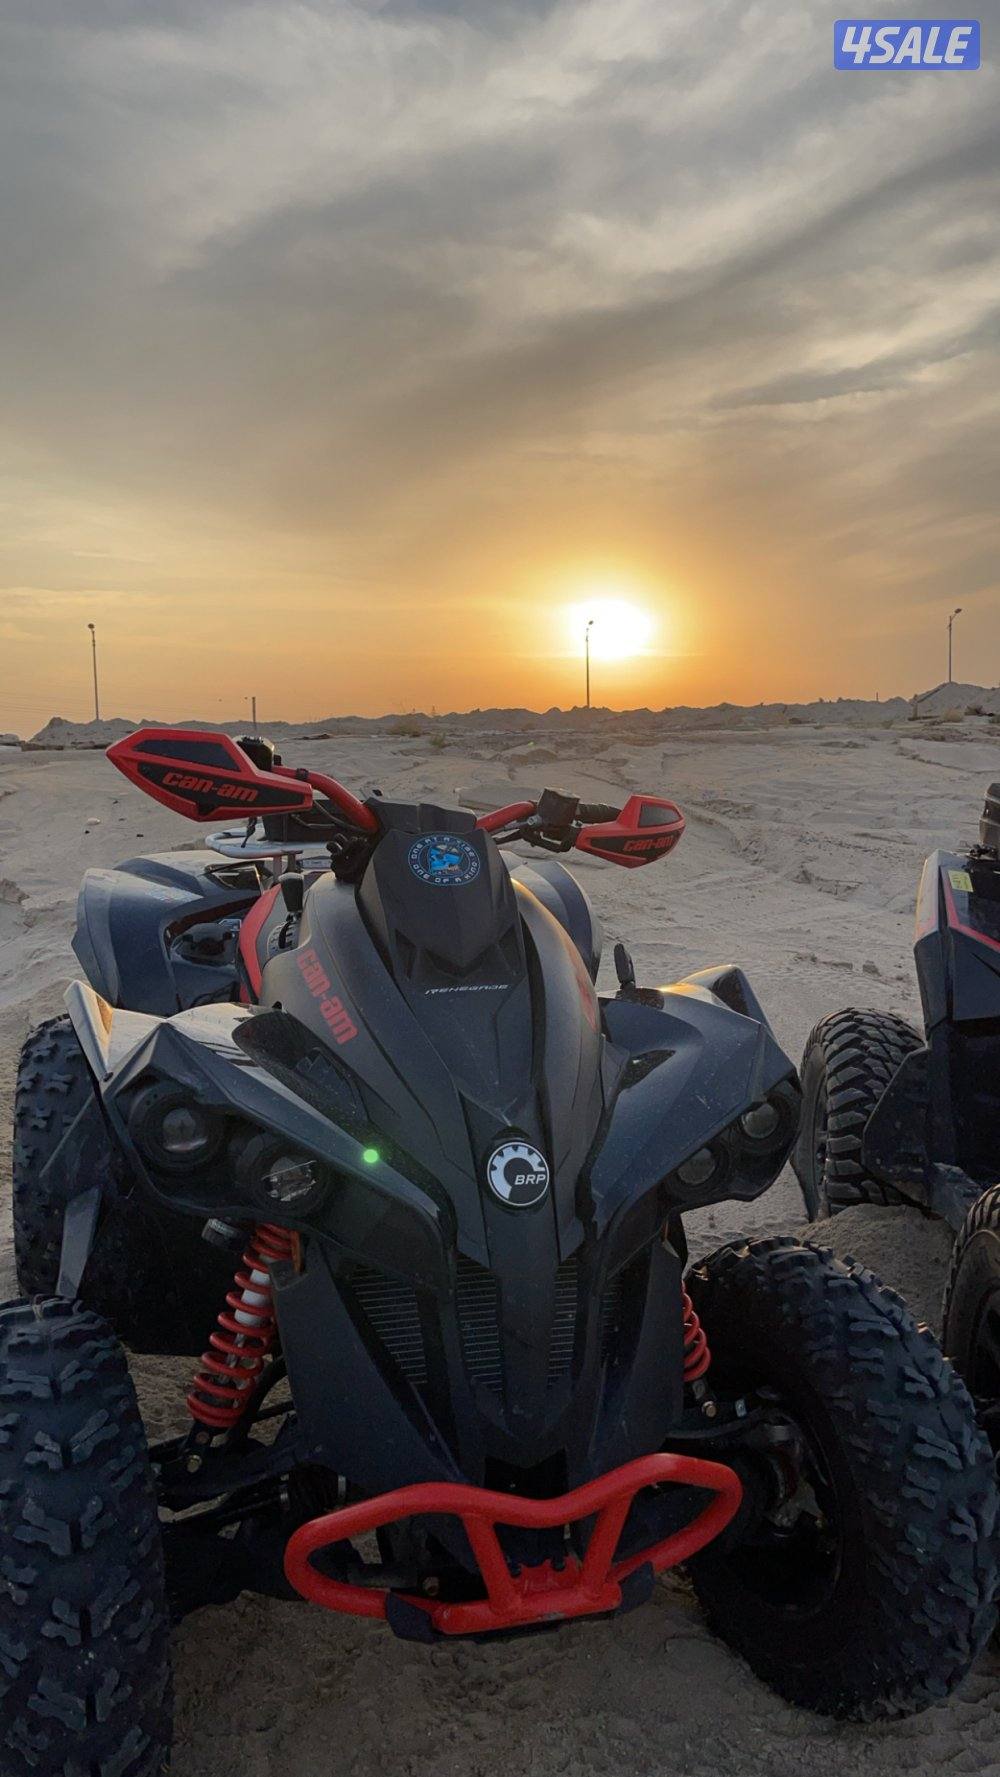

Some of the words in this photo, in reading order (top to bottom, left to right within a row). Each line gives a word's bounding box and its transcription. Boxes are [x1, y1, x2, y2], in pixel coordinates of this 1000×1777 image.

[162, 772, 259, 802] can-am
[297, 948, 358, 1044] can-am
[425, 984, 508, 995] RENEGADE
[514, 1174, 546, 1186] BRP
